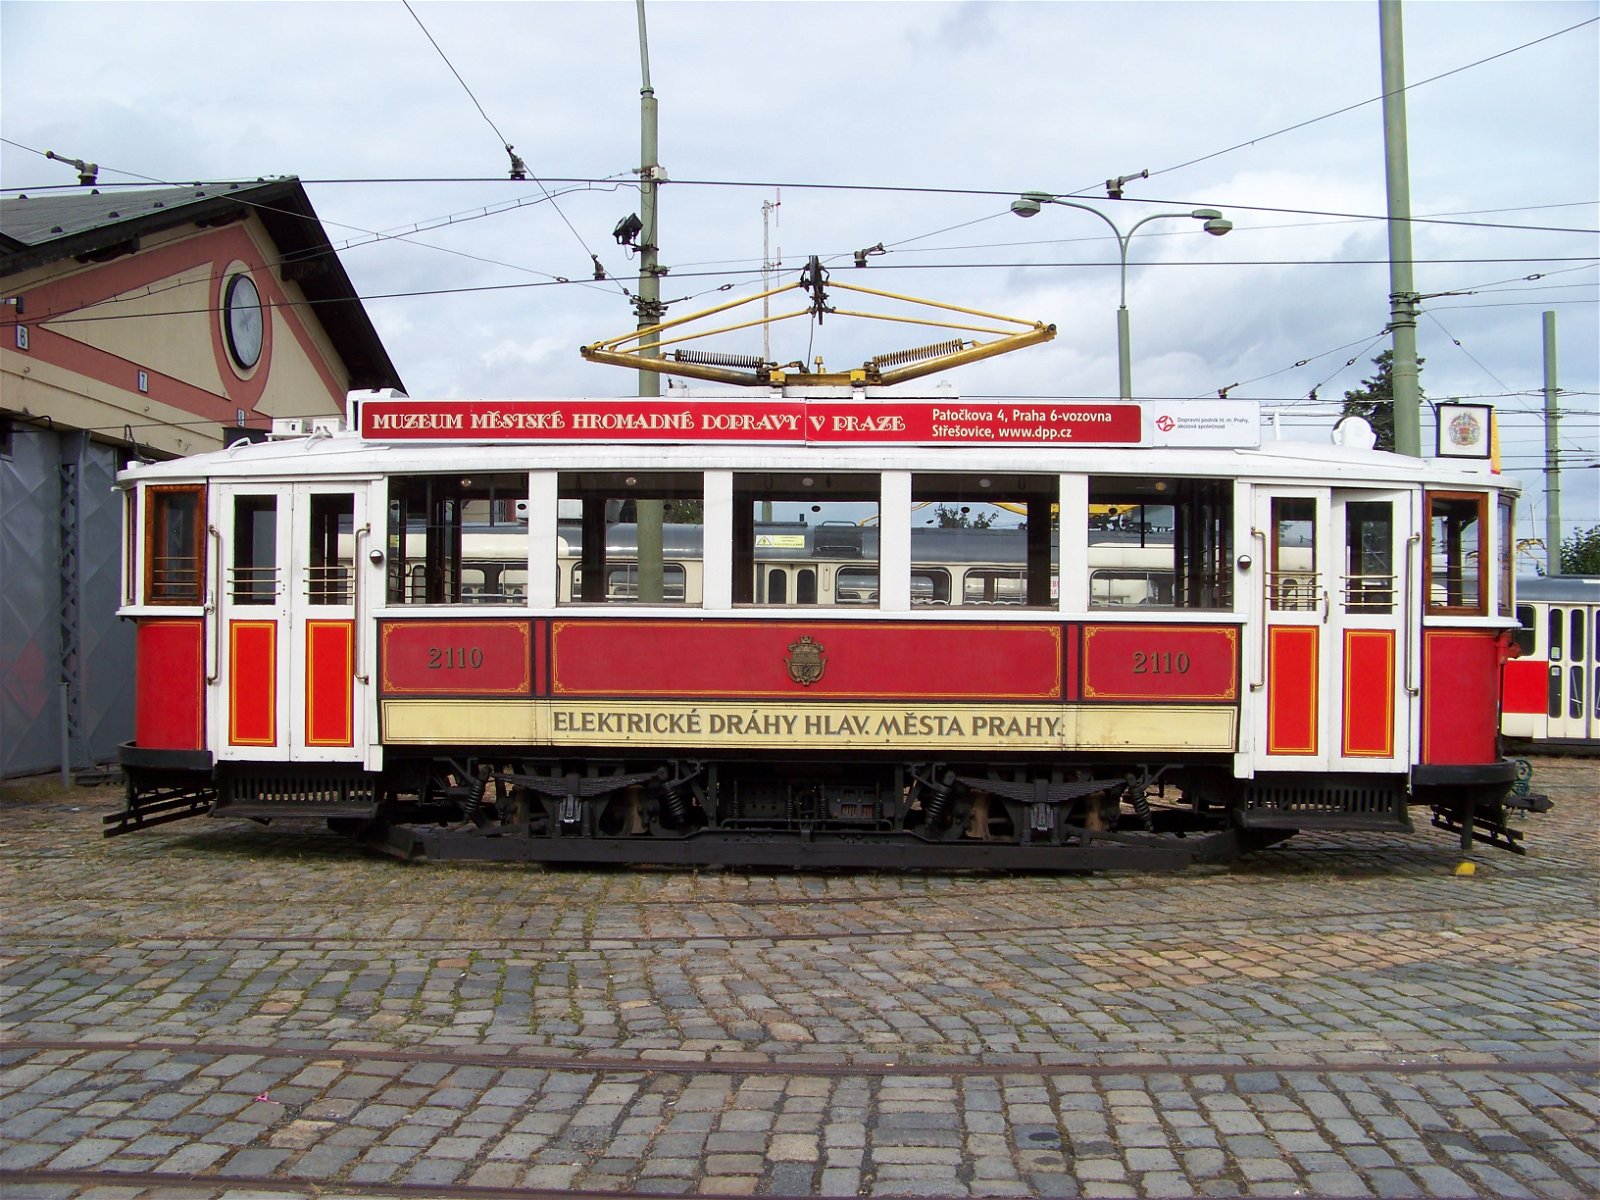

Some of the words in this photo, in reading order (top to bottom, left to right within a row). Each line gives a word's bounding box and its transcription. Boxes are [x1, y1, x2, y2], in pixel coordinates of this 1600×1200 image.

[19, 328, 26, 347] 6
[372, 413, 463, 430] MUZEUM
[470, 410, 565, 430] MĚSTSKÉ
[572, 410, 695, 430] HROMADNÉ
[701, 413, 802, 431] DOPRAVY
[809, 415, 826, 432] V
[832, 415, 906, 432] PRAZE
[932, 408, 992, 421] Patočkova
[997, 409, 1008, 423] 4,
[1013, 409, 1046, 422] Praha
[1050, 409, 1112, 422] 6-vozovna
[932, 424, 995, 438] Střešovice,
[998, 425, 1073, 440] www.dpp.cz
[427, 647, 484, 669] 2110
[1133, 652, 1190, 674] 2110
[553, 708, 702, 734] ELEKTRICKÉ
[709, 709, 798, 735] DRÁHY
[804, 713, 870, 736] HLAV.
[875, 712, 966, 737] MĚSTA
[972, 715, 1062, 737] PRAHY.
